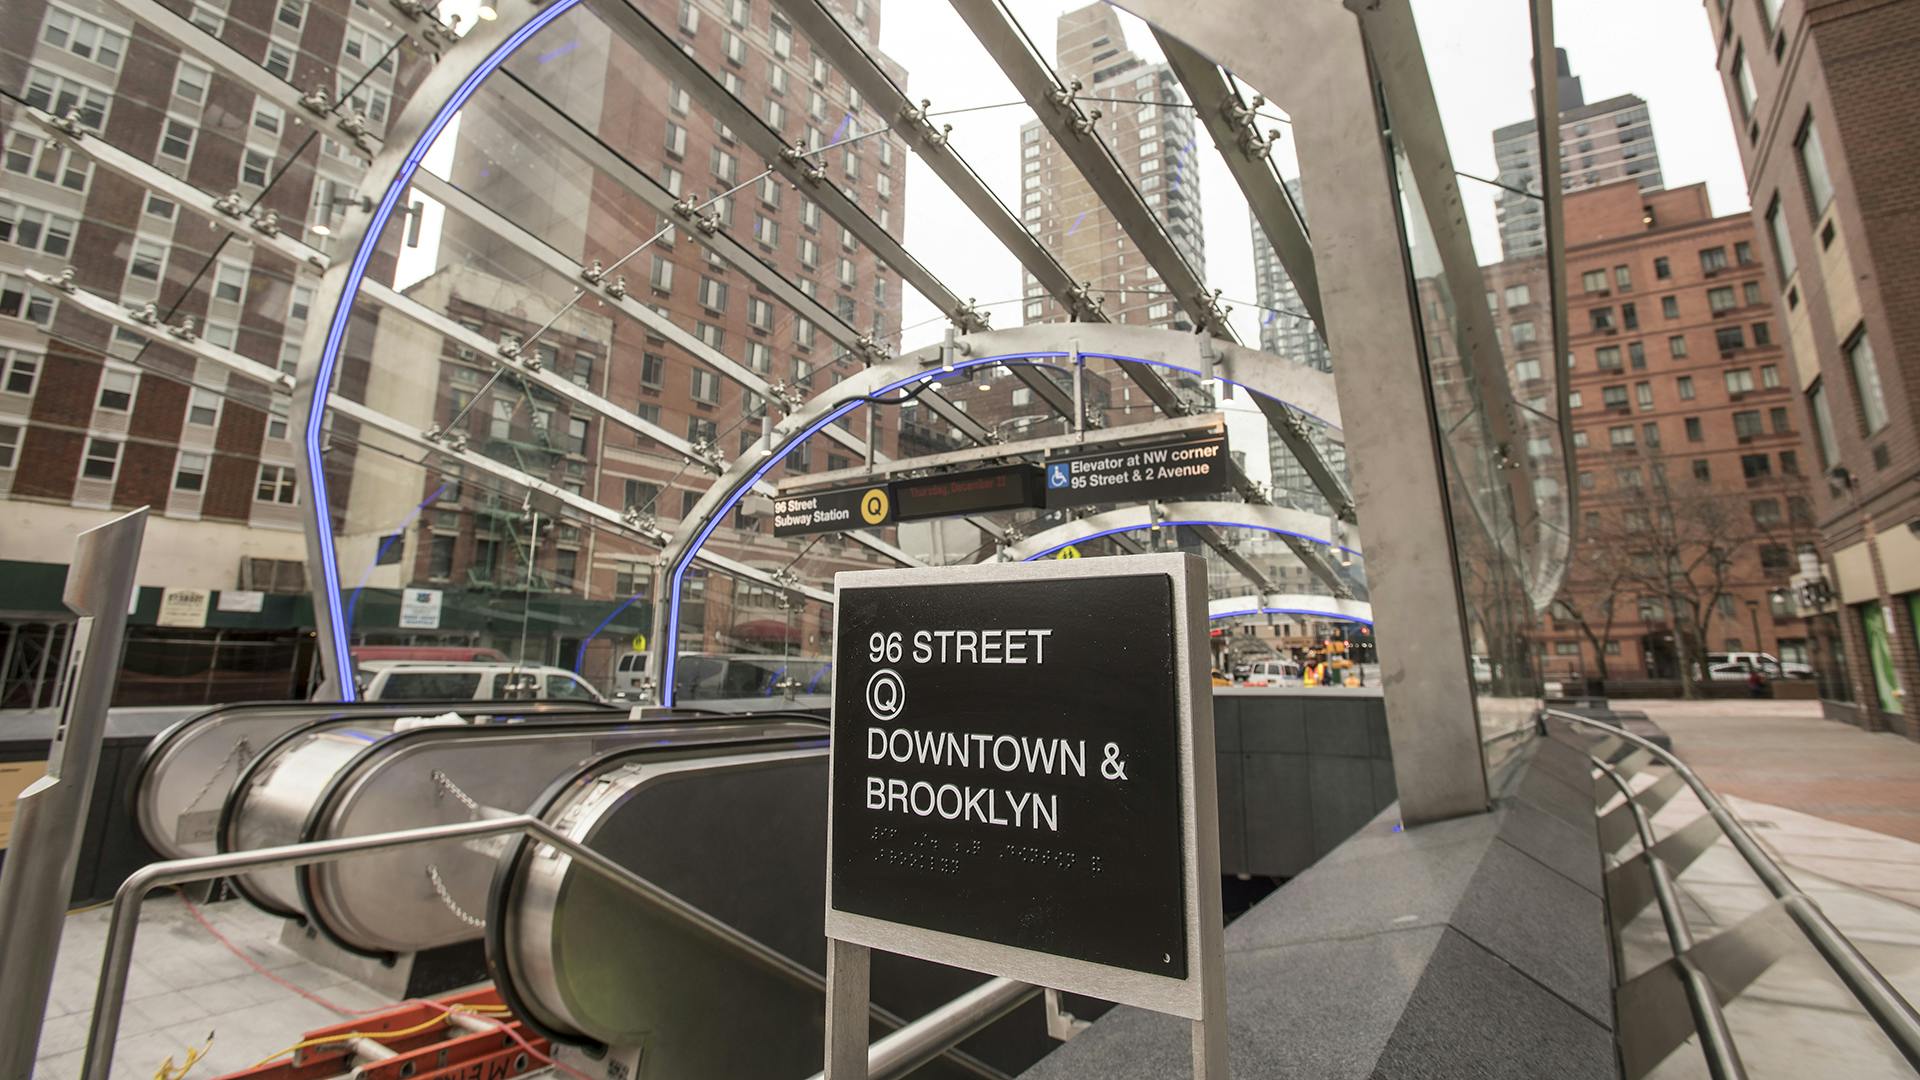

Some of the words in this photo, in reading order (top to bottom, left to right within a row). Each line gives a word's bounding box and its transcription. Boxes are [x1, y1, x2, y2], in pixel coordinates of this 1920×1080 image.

[1071, 458, 1124, 474] Elevator
[1127, 454, 1140, 467] at
[1143, 450, 1168, 465] NW
[1171, 445, 1219, 461] corner
[1071, 476, 1087, 489] 95
[1089, 471, 1129, 487] Street
[1132, 469, 1142, 482] &
[1145, 468, 1154, 480] 2
[1157, 463, 1210, 479] Avenue
[774, 501, 787, 514] 96
[788, 498, 817, 512] Street
[774, 513, 812, 527] Subway
[813, 508, 849, 523] Station
[867, 496, 882, 516] Q
[869, 632, 903, 664] 96
[912, 629, 1053, 664] STREET
[873, 677, 898, 714] Q
[867, 727, 1086, 778] DOWNTOWN
[1100, 742, 1129, 781] &
[866, 776, 1058, 832] BROOKLYN
